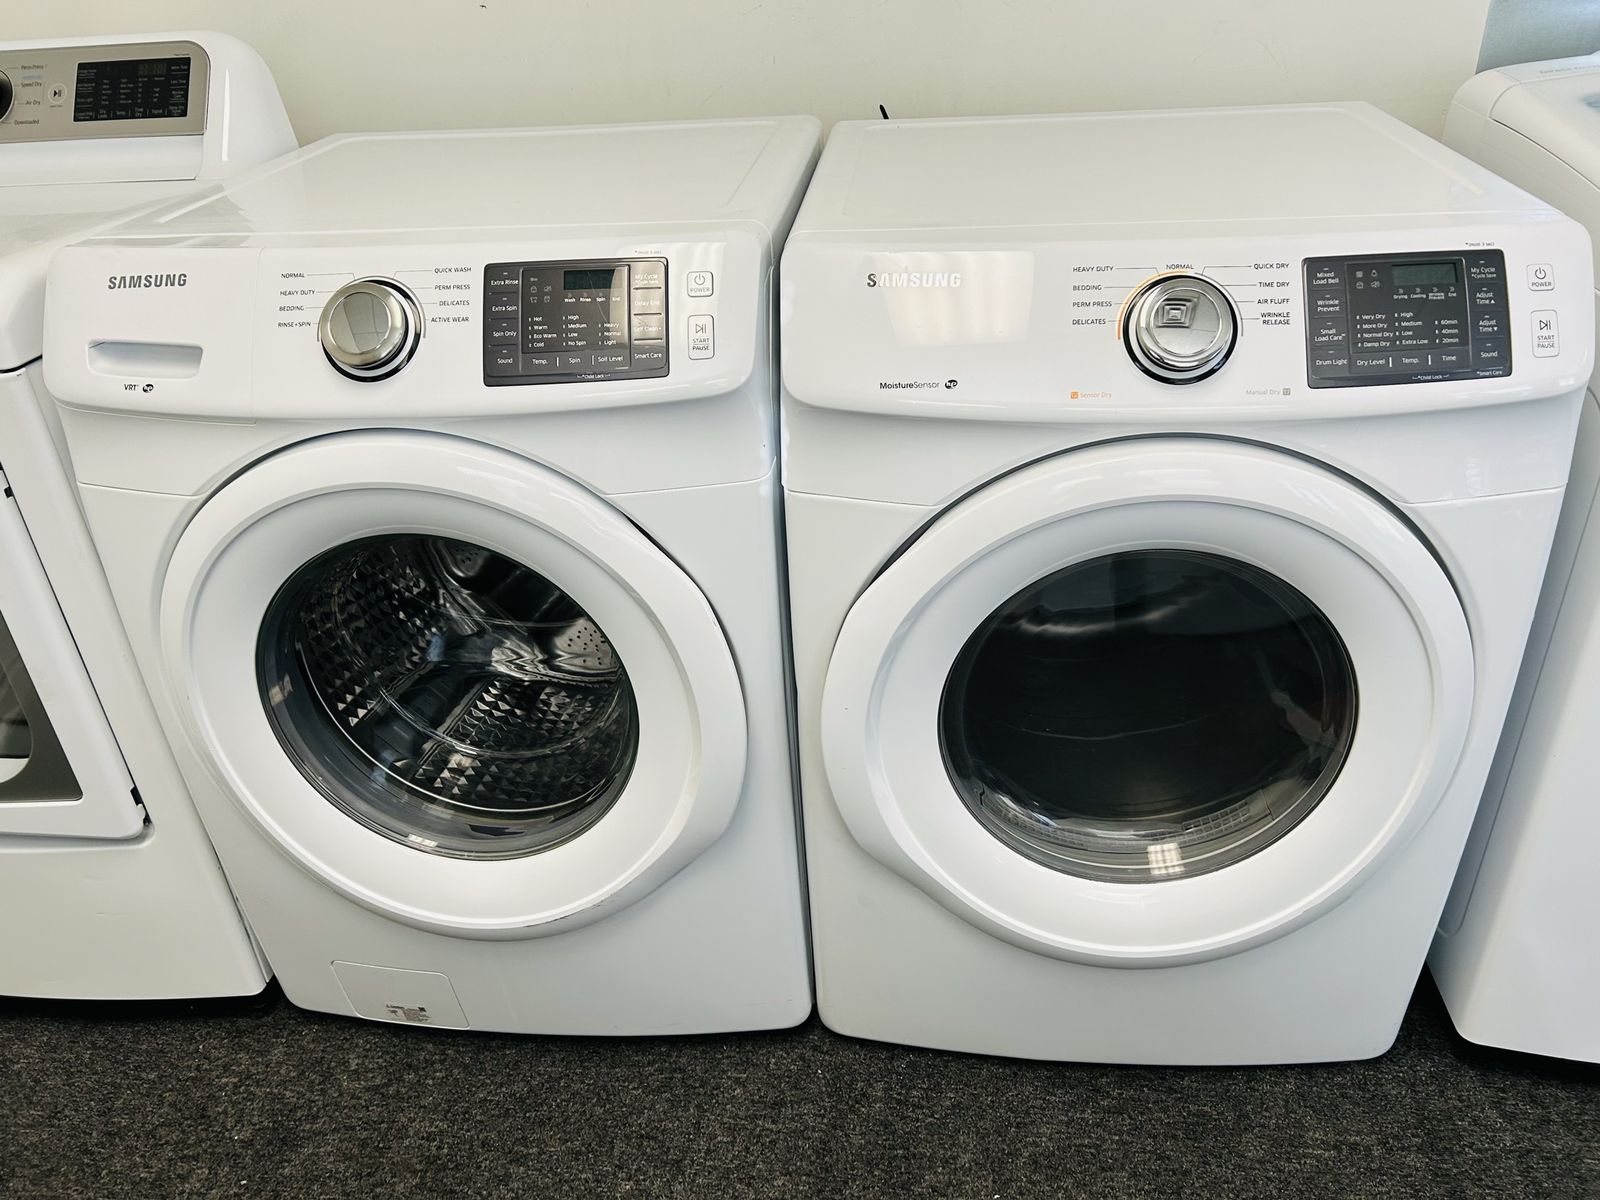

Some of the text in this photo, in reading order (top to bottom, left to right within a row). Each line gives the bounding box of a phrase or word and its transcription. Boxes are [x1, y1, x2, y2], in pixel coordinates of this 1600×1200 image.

[1480, 266, 1496, 274] Cycle
[108, 273, 188, 290] SAMSUNG
[866, 272, 961, 288] SAMSUNG
[1072, 284, 1102, 292] BEDDING
[1092, 300, 1112, 308] PRESS
[1072, 318, 1106, 326] DELICATES
[504, 330, 517, 338] Only
[1380, 340, 1390, 348] Dry
[1332, 358, 1348, 366] Light
[1369, 358, 1386, 366] Level
[879, 381, 940, 390] MoistureSensor
